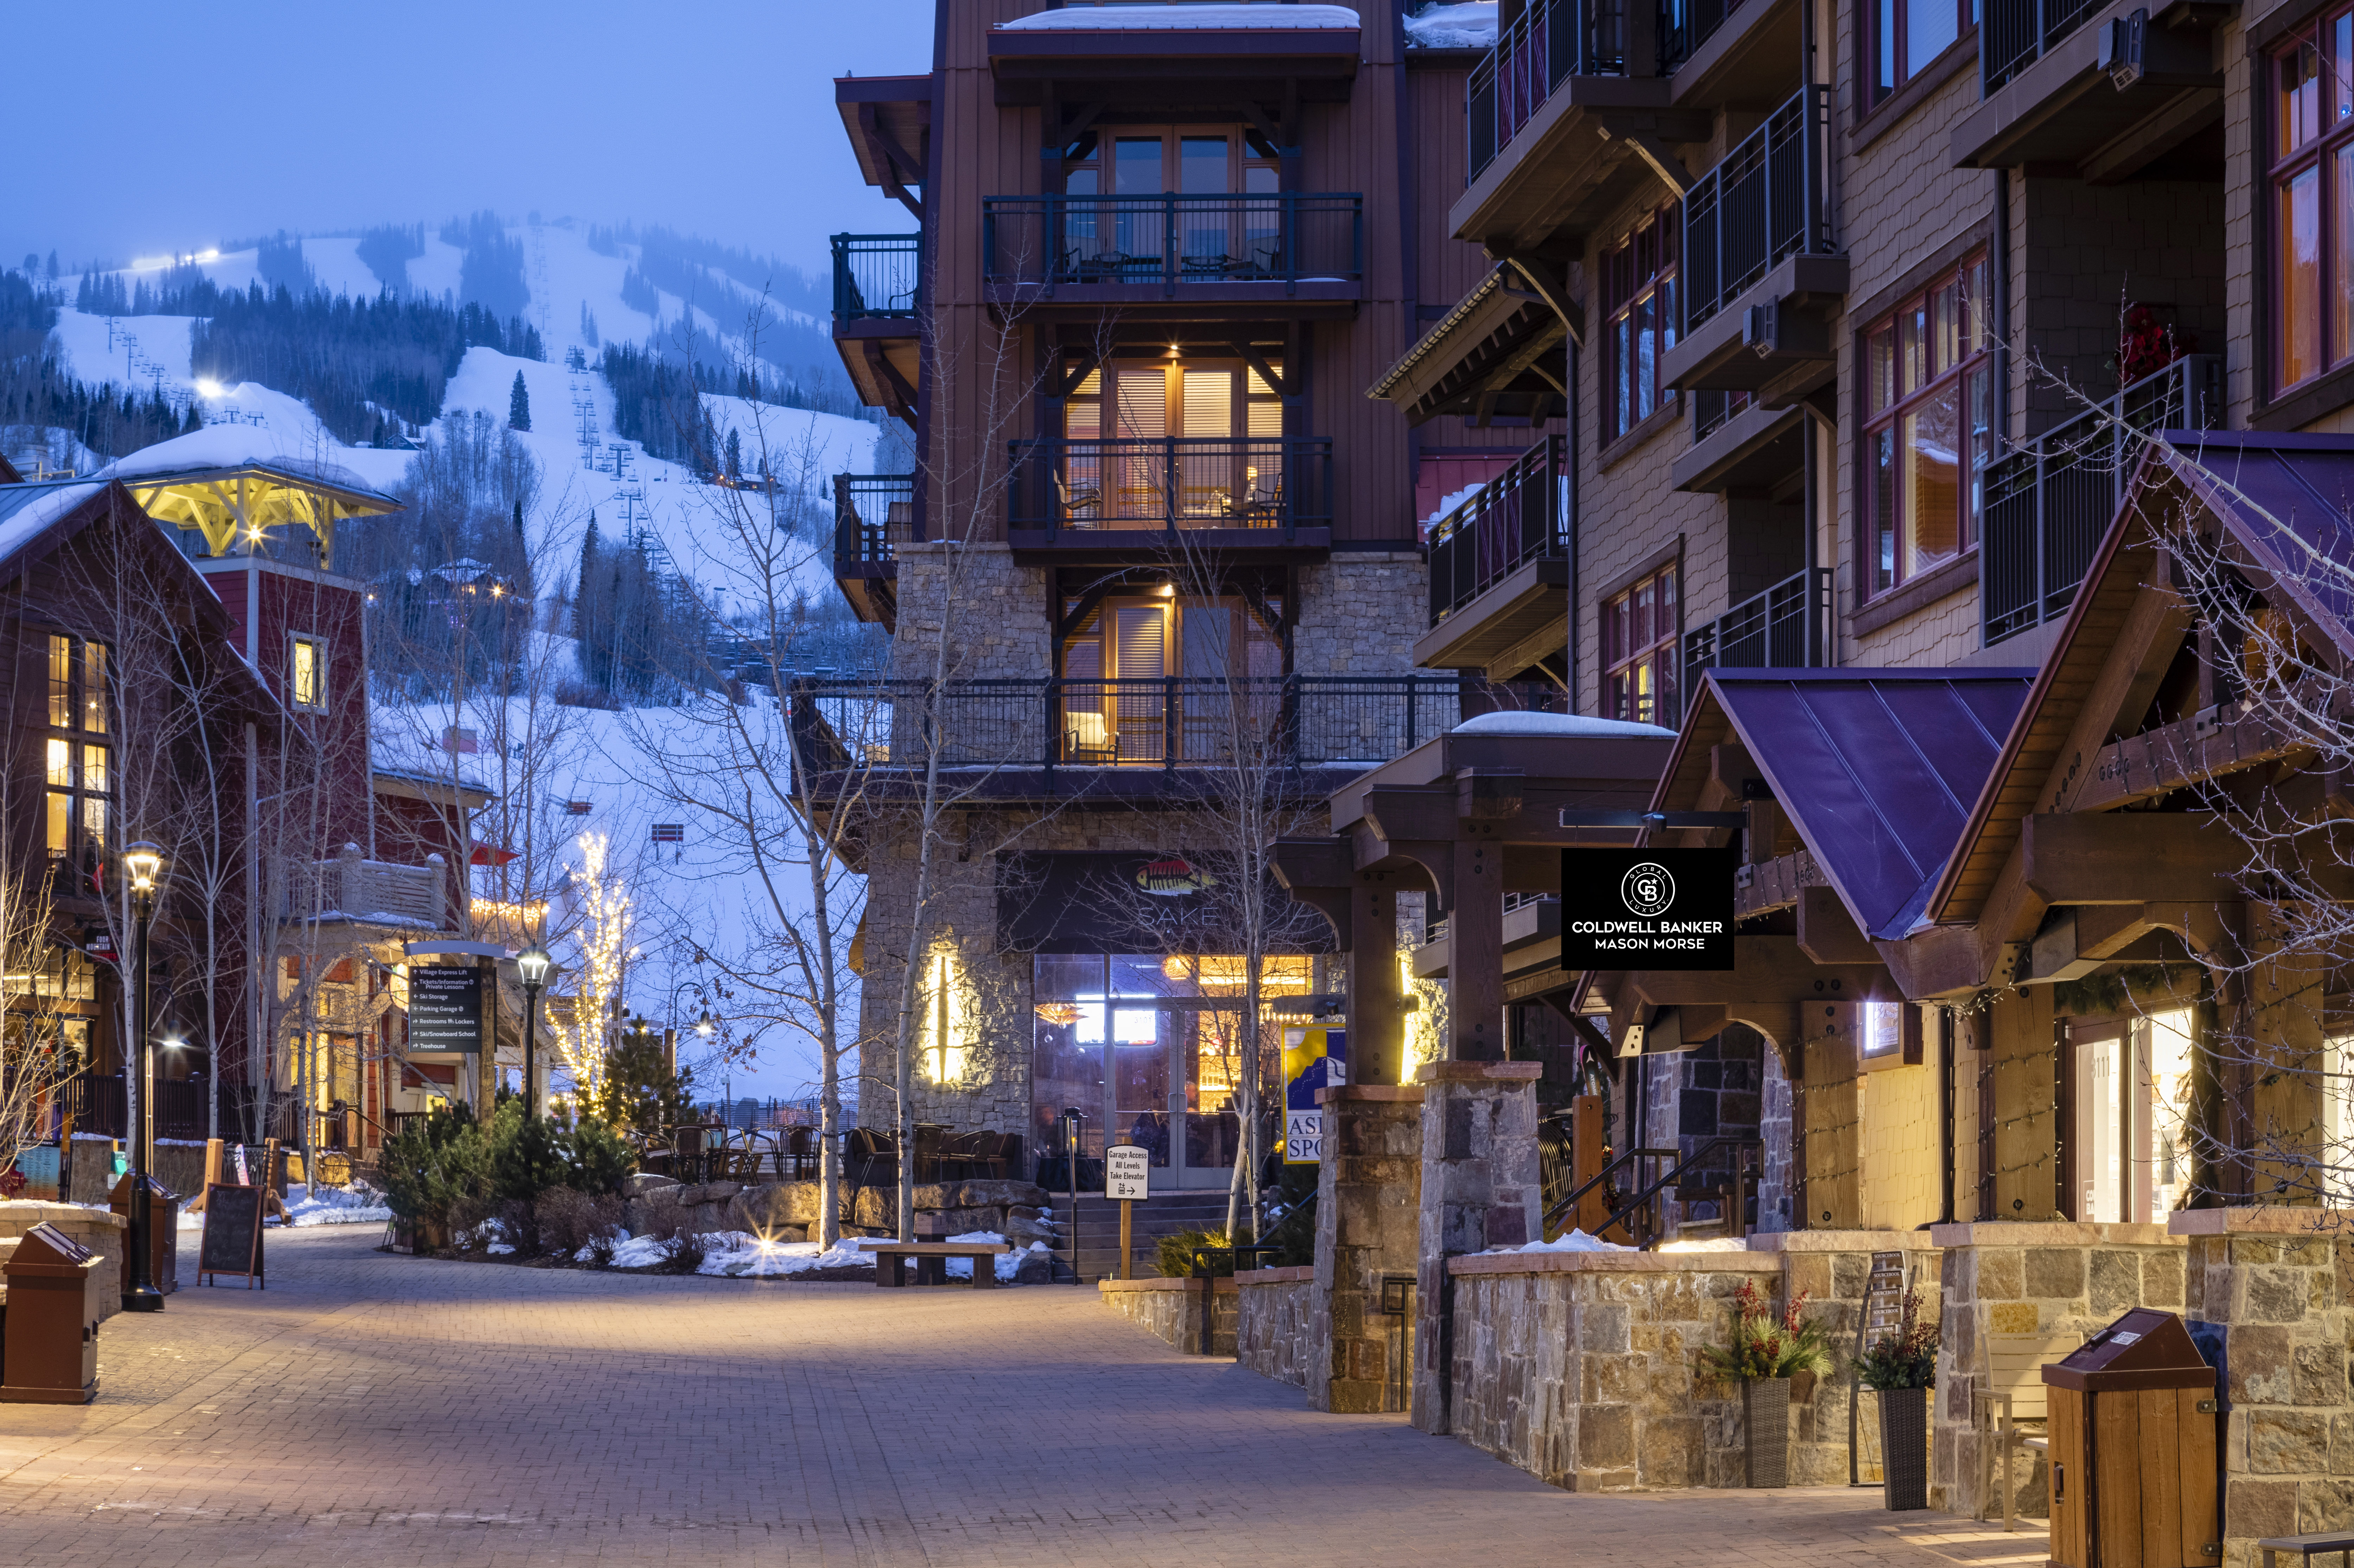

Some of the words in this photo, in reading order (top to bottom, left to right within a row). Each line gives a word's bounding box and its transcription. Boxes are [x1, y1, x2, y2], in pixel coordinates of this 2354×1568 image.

[1630, 867, 1666, 879] GLOBAL
[1629, 900, 1666, 912] LUXURY
[1572, 922, 1656, 933] COLDWELL
[1661, 922, 1722, 933] BANKER
[1595, 939, 1648, 949] MASON
[1654, 939, 1705, 949] MORSE
[2091, 1055, 2110, 1079] 3111
[1109, 1151, 1127, 1159] Garage
